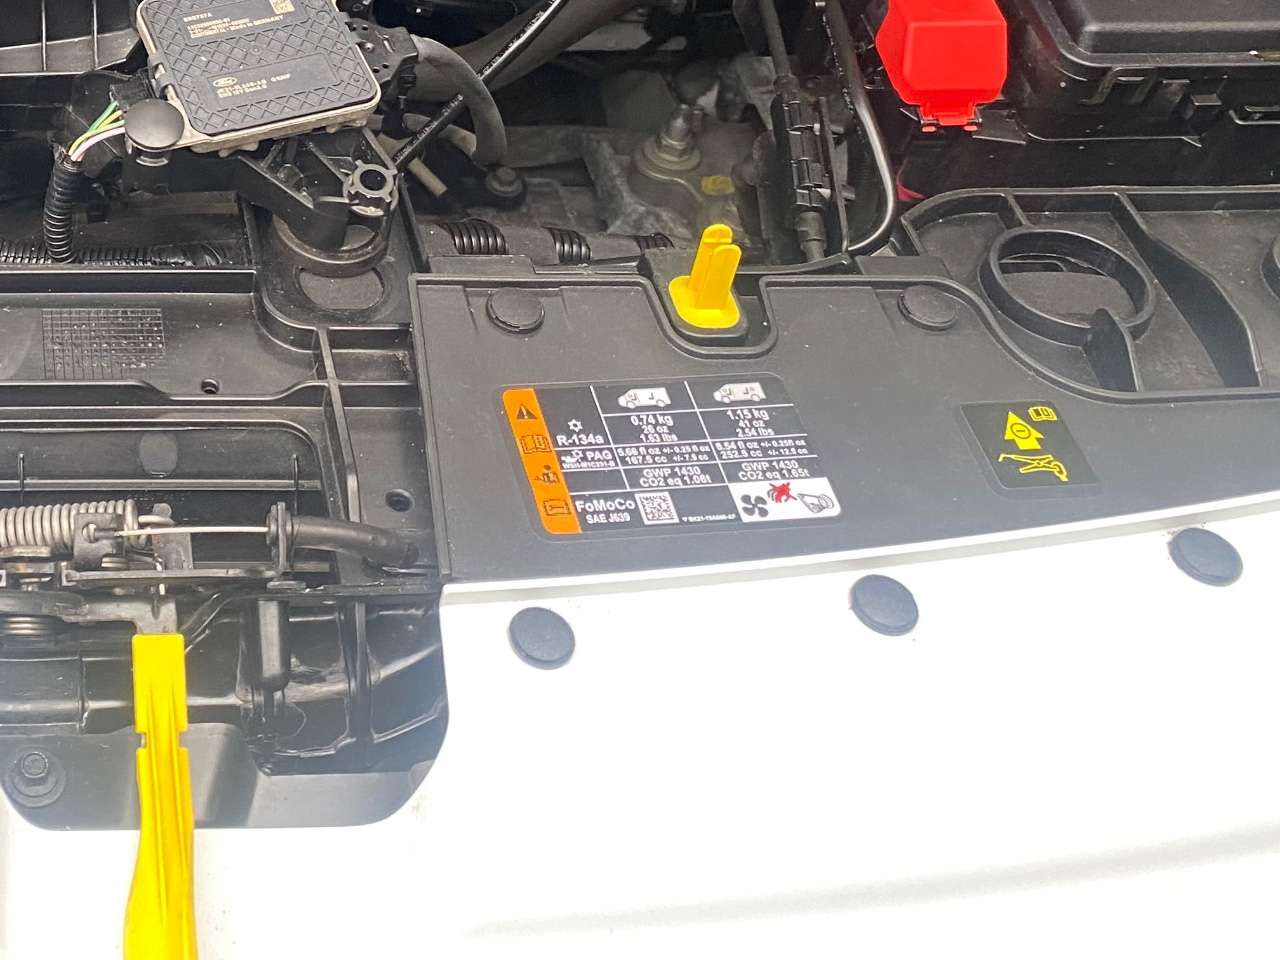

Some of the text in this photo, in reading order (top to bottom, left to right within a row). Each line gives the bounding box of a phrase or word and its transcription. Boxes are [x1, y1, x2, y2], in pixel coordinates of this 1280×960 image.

[726, 409, 770, 421] 1.15 kg
[631, 415, 674, 427] 0.74 kg
[757, 427, 775, 436] lbs
[556, 434, 604, 446] R-134a
[661, 433, 678, 442] lbs
[586, 450, 613, 461] PAG
[742, 460, 798, 472] GWP 1430
[643, 466, 701, 478] GWP 1430
[738, 470, 763, 481] CO2
[639, 477, 666, 487] CO2
[575, 496, 636, 512] FoMoCo
[585, 513, 608, 524] SAE
